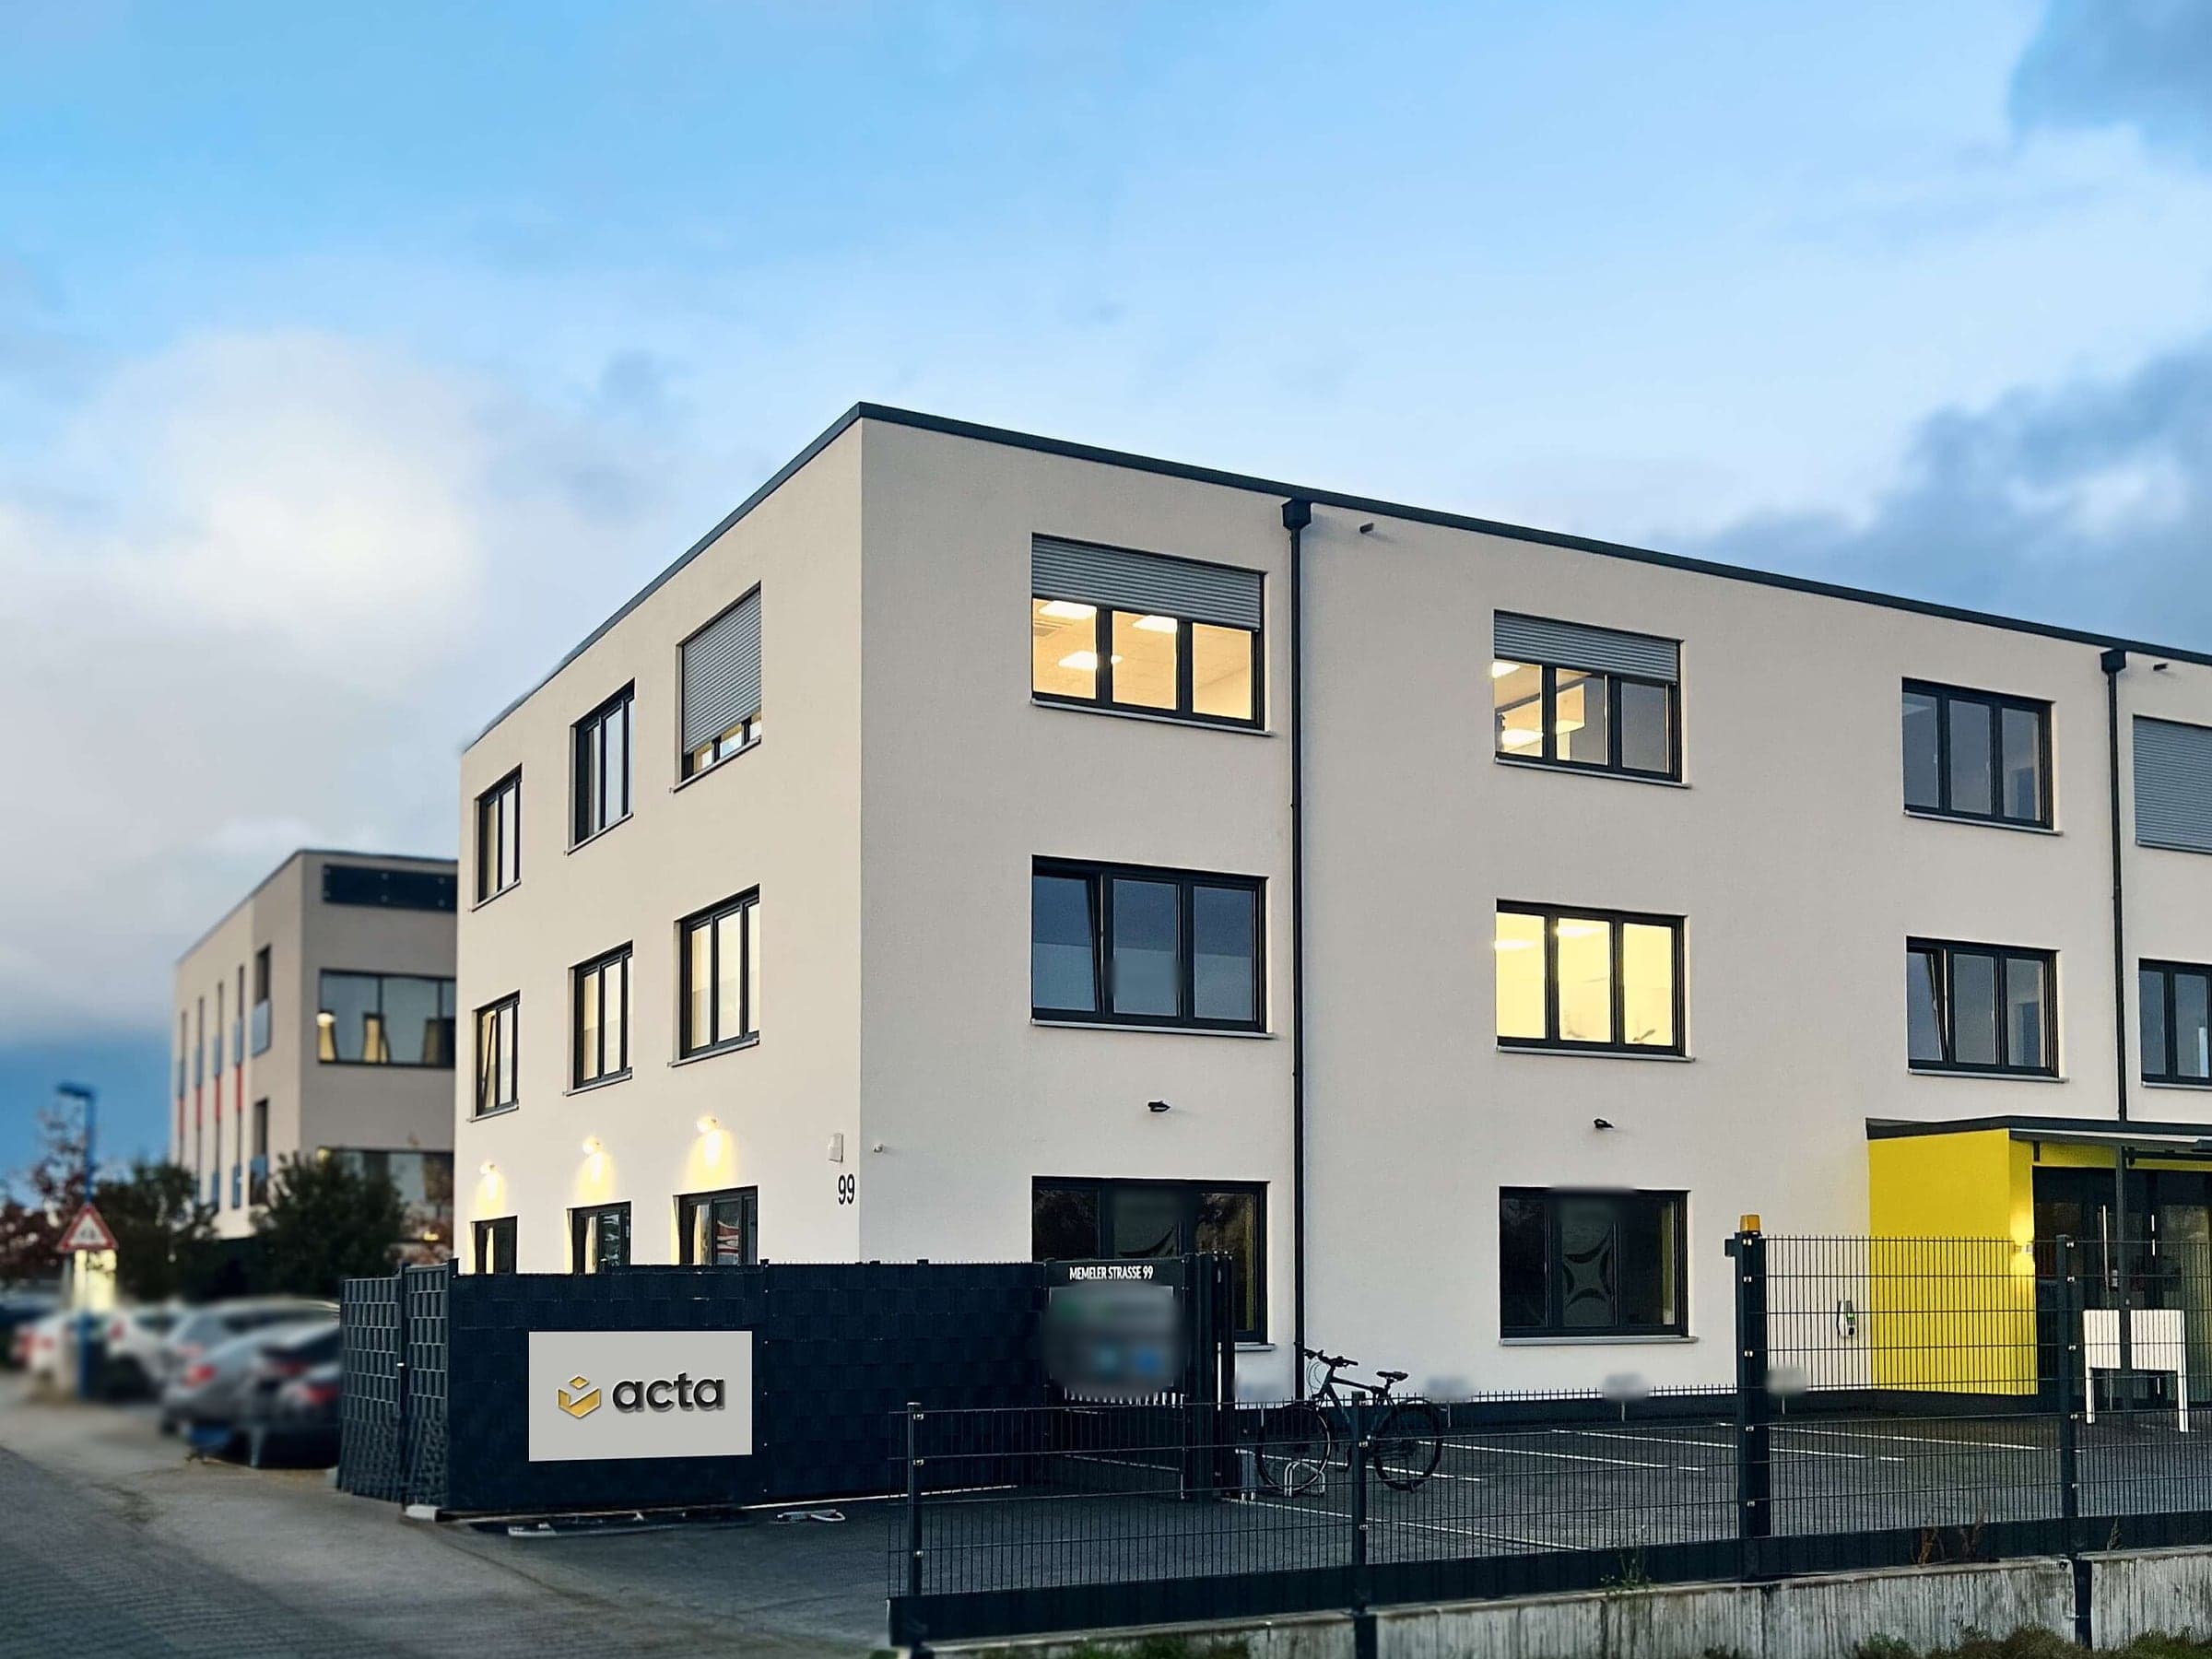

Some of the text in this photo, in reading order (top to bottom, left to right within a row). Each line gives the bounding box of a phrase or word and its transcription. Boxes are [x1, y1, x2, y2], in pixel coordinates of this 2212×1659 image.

[838, 1173, 855, 1205] 99
[1069, 1265, 1154, 1280] MEMELER STRASSE 99
[612, 1371, 725, 1412] acta
